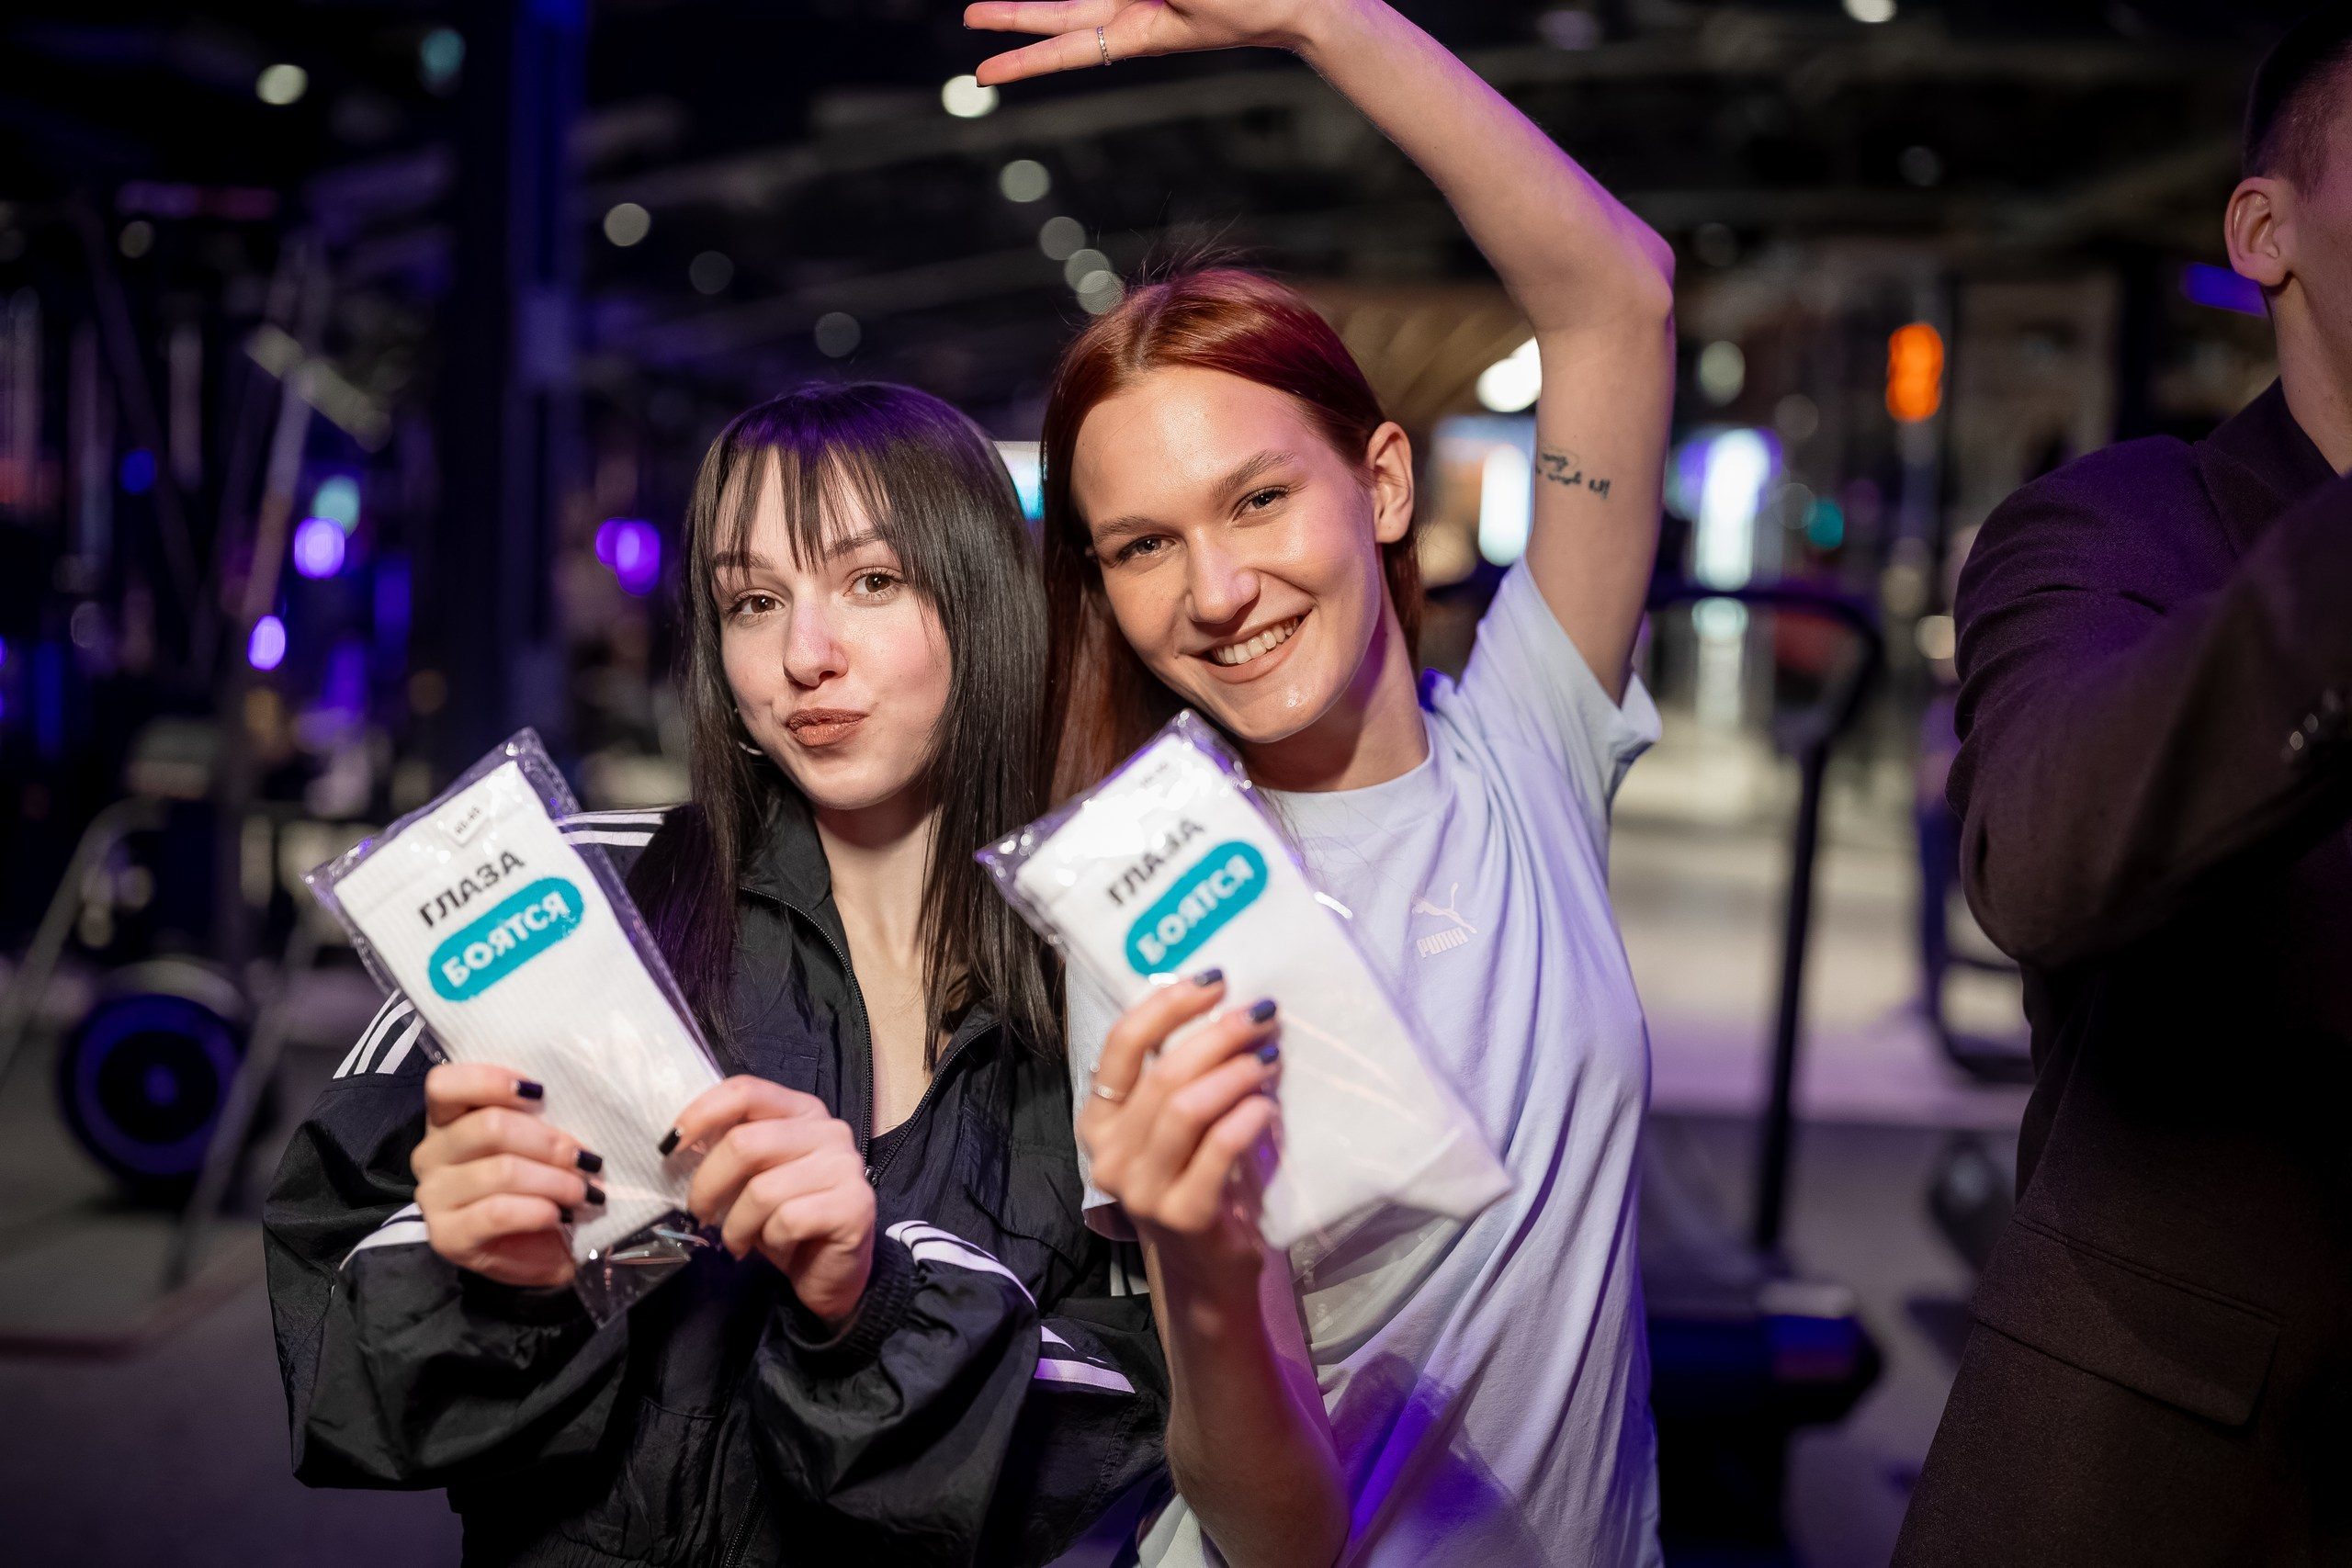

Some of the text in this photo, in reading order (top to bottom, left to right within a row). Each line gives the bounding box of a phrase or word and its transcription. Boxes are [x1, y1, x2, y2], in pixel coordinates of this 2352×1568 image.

[420, 851, 526, 928] ГЛАЗА
[1136, 854, 1255, 965] БОЯТСЯ
[441, 890, 571, 987] БОЯТСЯ
[1416, 927, 1469, 958] PUMA
